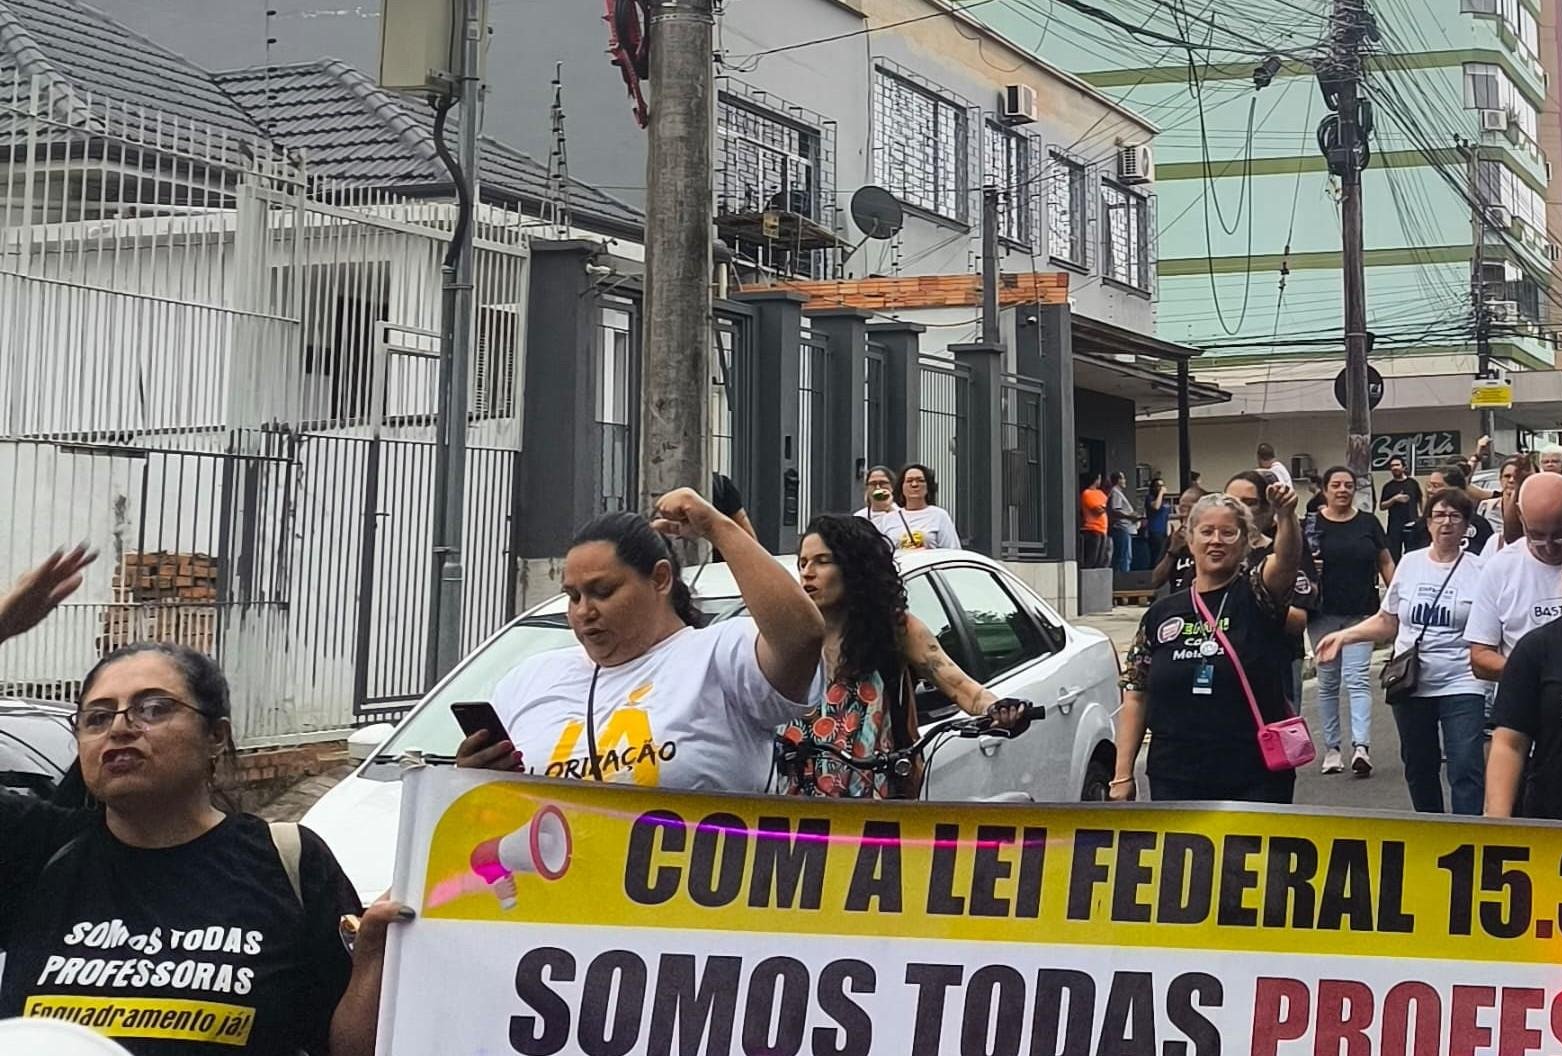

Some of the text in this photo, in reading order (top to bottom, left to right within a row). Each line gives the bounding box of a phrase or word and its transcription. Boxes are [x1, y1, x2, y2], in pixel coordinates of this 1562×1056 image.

[528, 738, 677, 781] ORIAÇÃO
[624, 809, 831, 911] COM
[844, 820, 903, 914] A
[926, 823, 1048, 919] LEI
[1066, 828, 1415, 934] FEDERAL
[63, 918, 266, 956] SOMOS TODAS
[36, 954, 255, 996] PROFESSORAS
